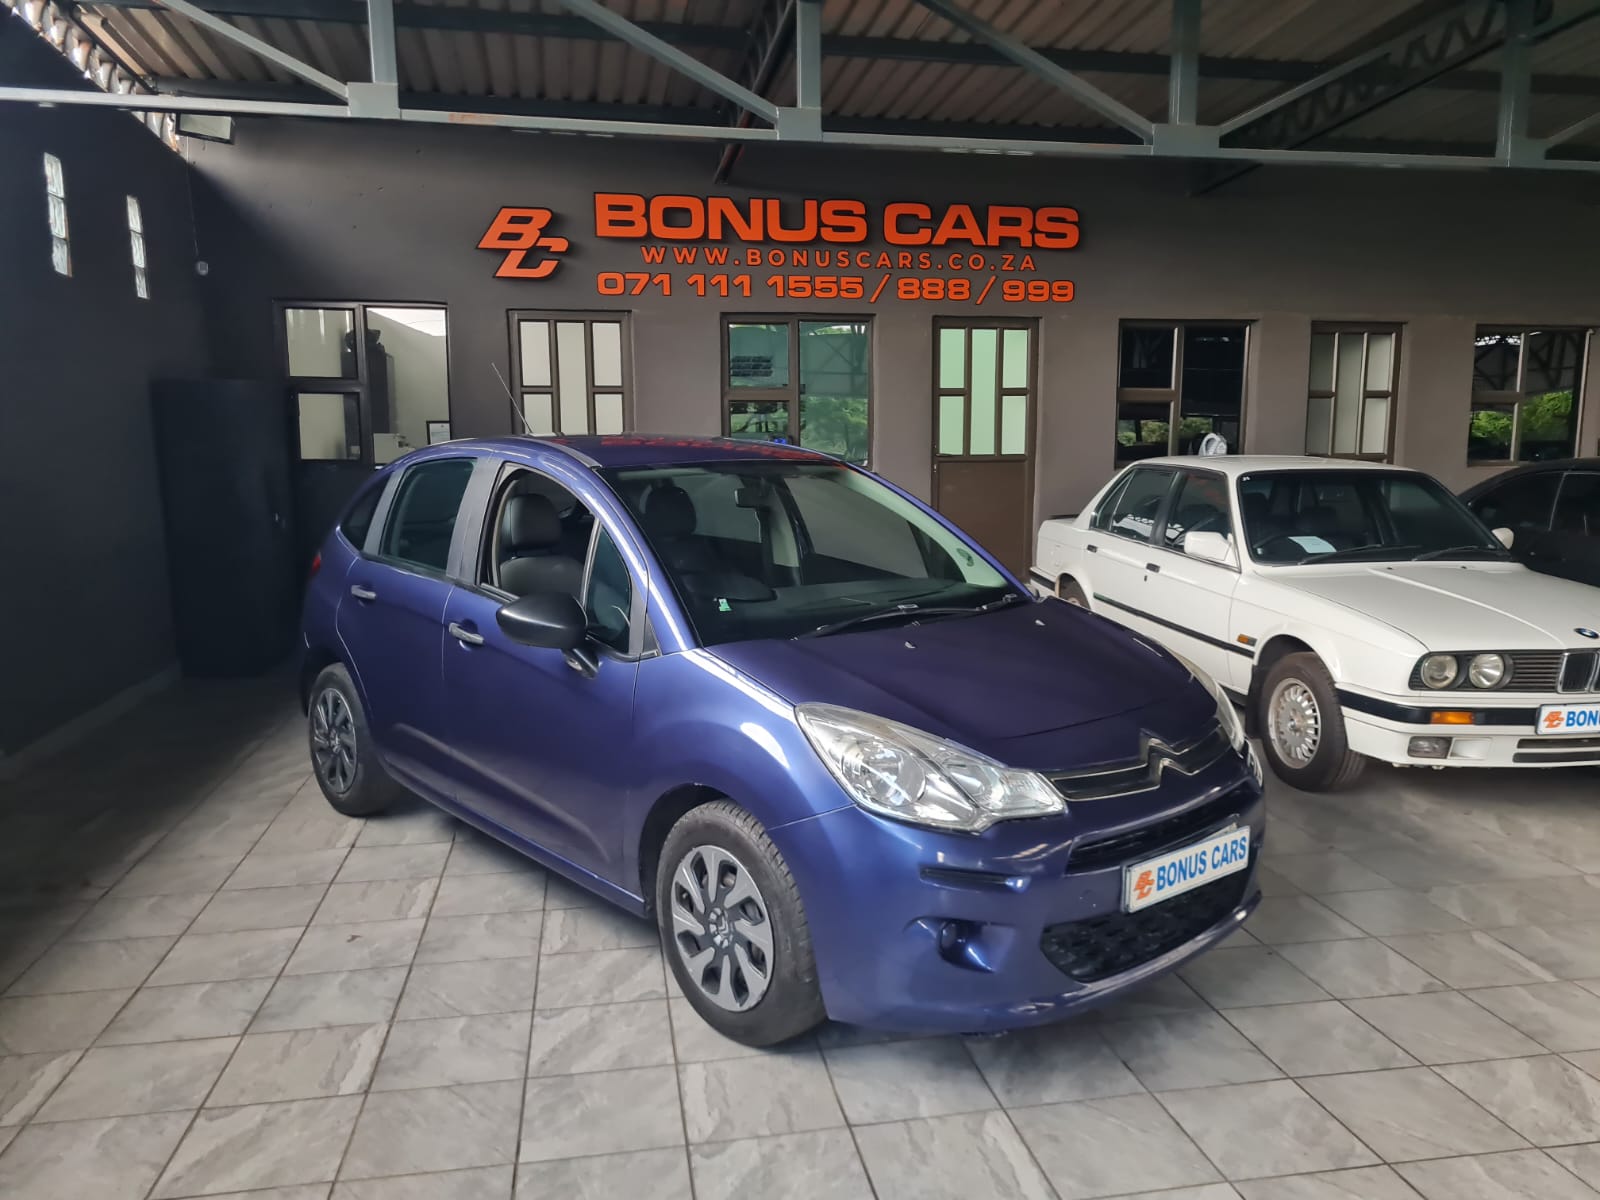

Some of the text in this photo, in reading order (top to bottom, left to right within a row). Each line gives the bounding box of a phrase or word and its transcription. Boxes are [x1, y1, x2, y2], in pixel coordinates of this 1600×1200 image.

[477, 206, 569, 279] BC
[594, 193, 1080, 249] BONUS CARS
[596, 272, 672, 297] 071
[686, 273, 751, 297] 111
[640, 246, 1036, 272] WWW.BONUSCARS.CO.ZA
[1156, 849, 1207, 891] BONUS
[1211, 836, 1247, 870] CARS
